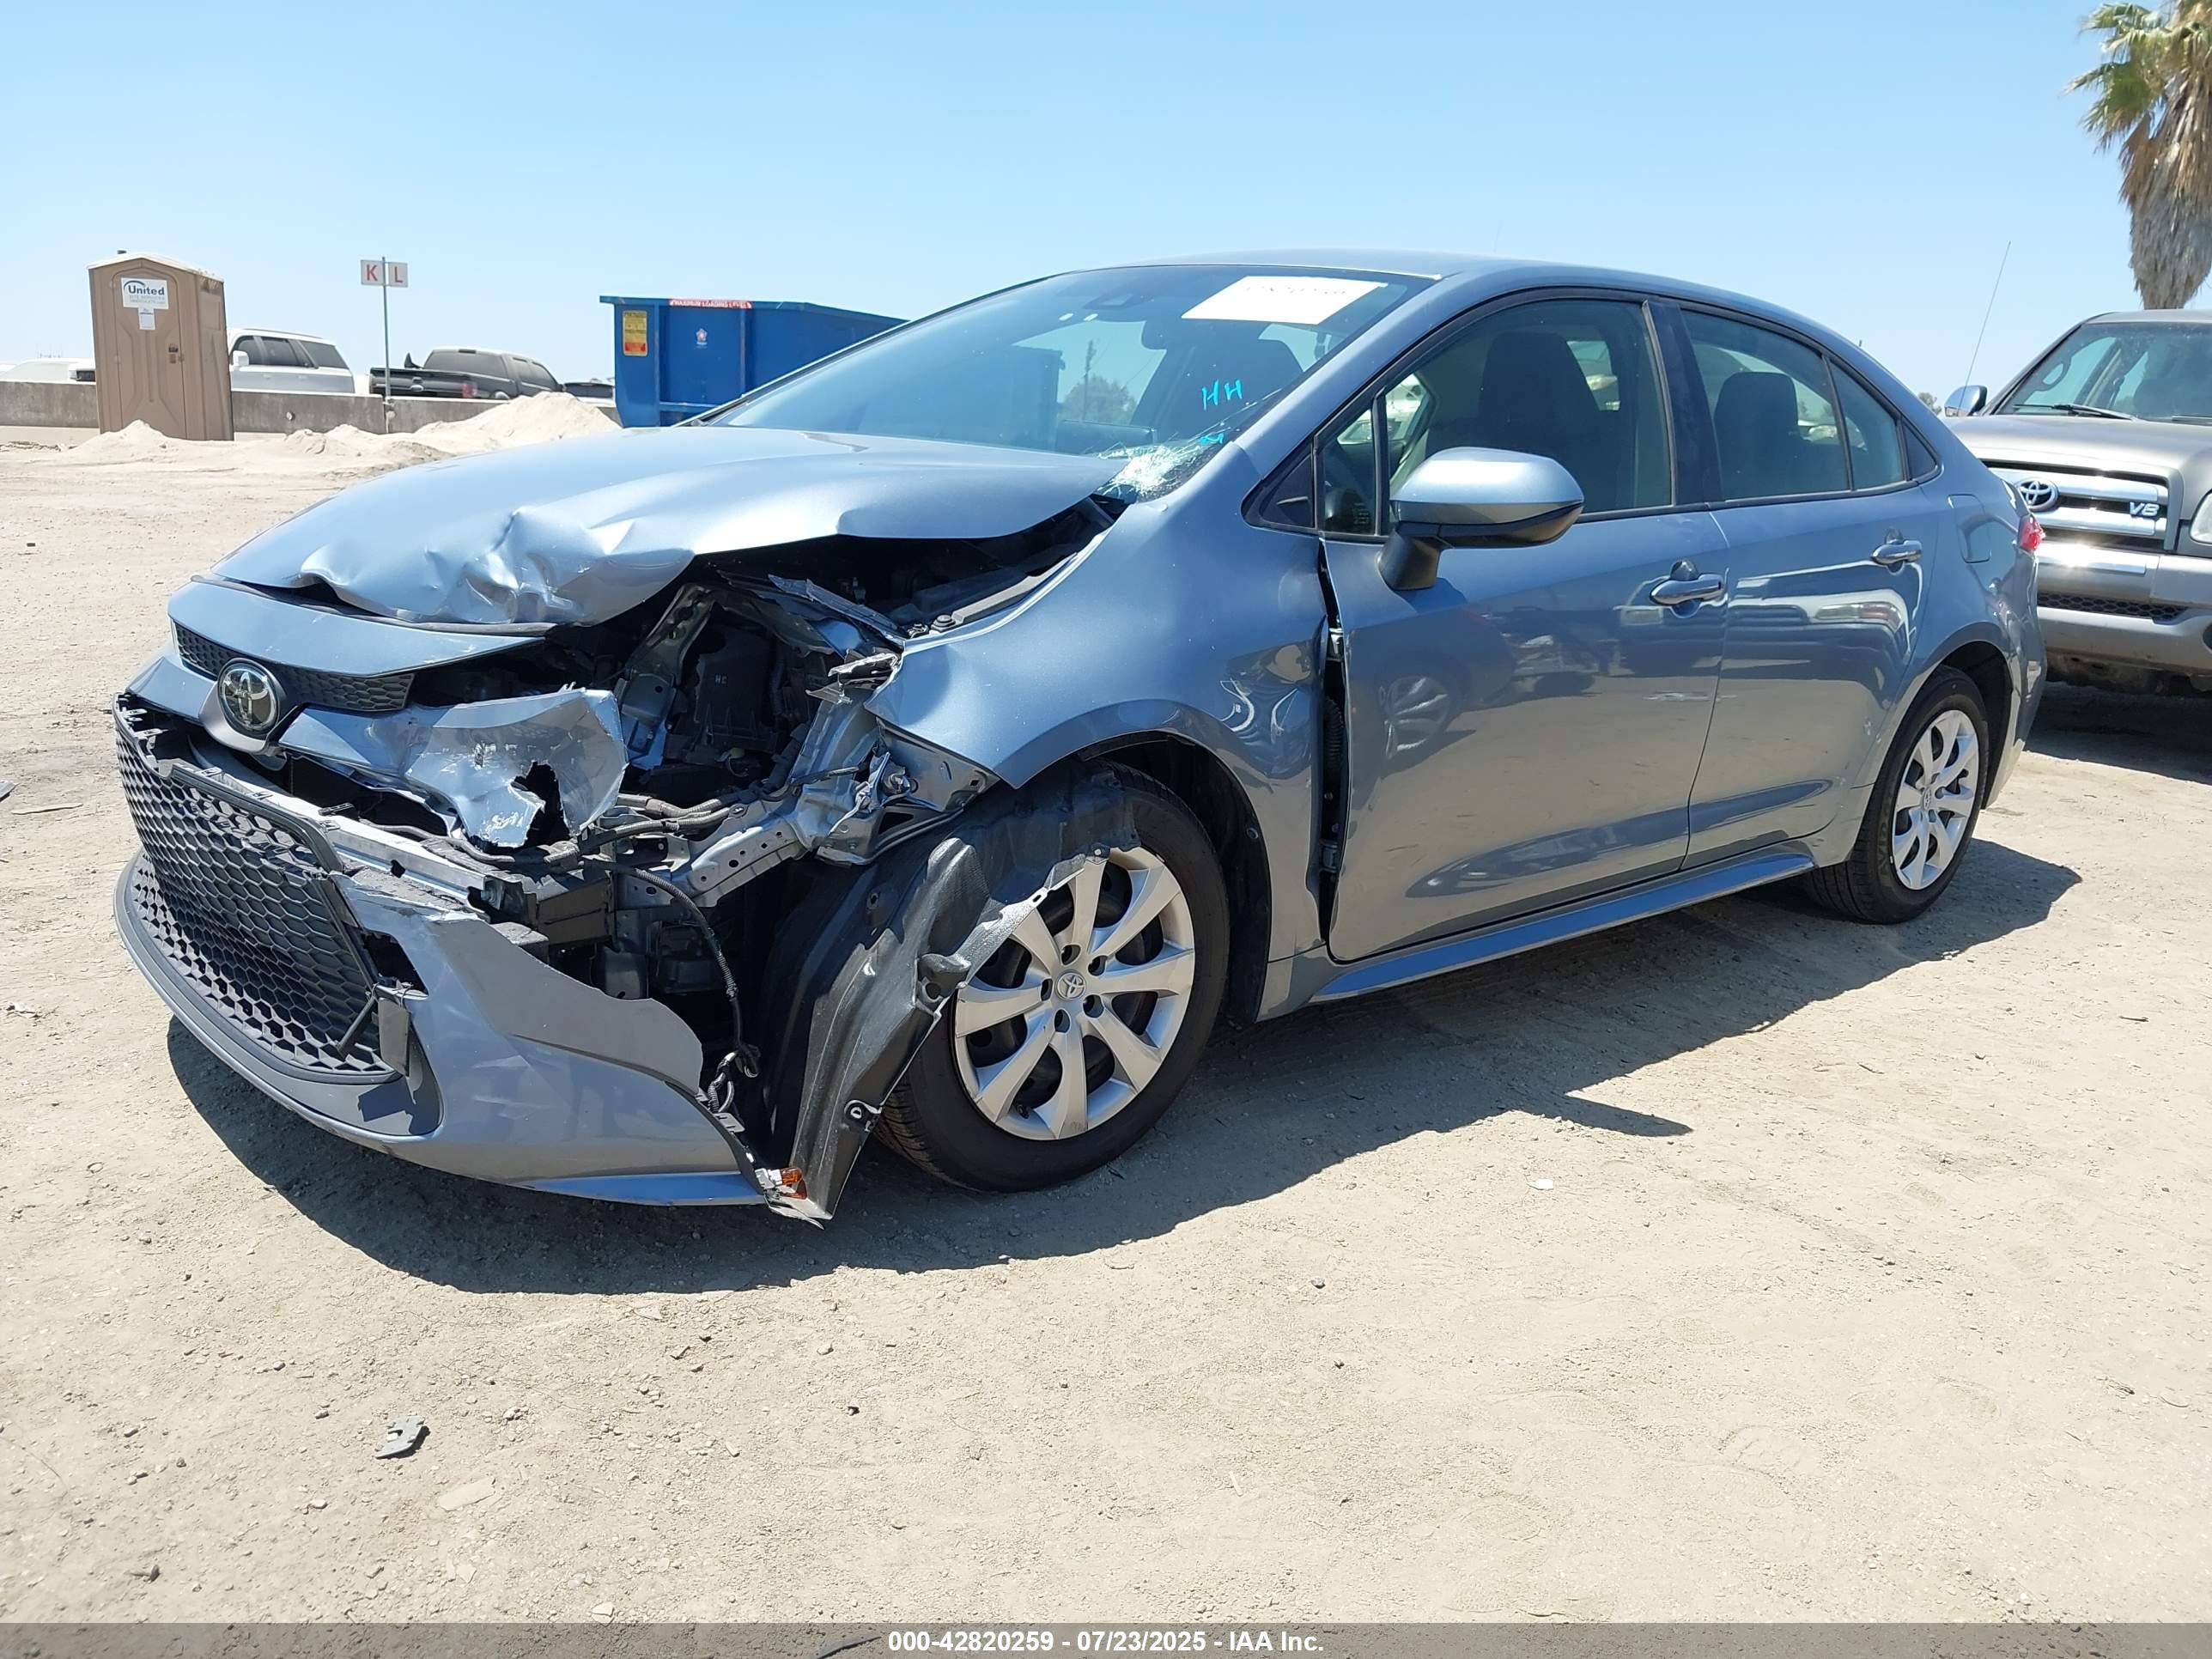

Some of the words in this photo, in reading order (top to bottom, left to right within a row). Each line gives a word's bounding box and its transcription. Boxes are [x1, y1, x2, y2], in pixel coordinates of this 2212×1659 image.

[367, 264, 378, 281] K
[395, 266, 404, 283] L
[128, 285, 165, 295] United
[2130, 501, 2160, 516] V8
